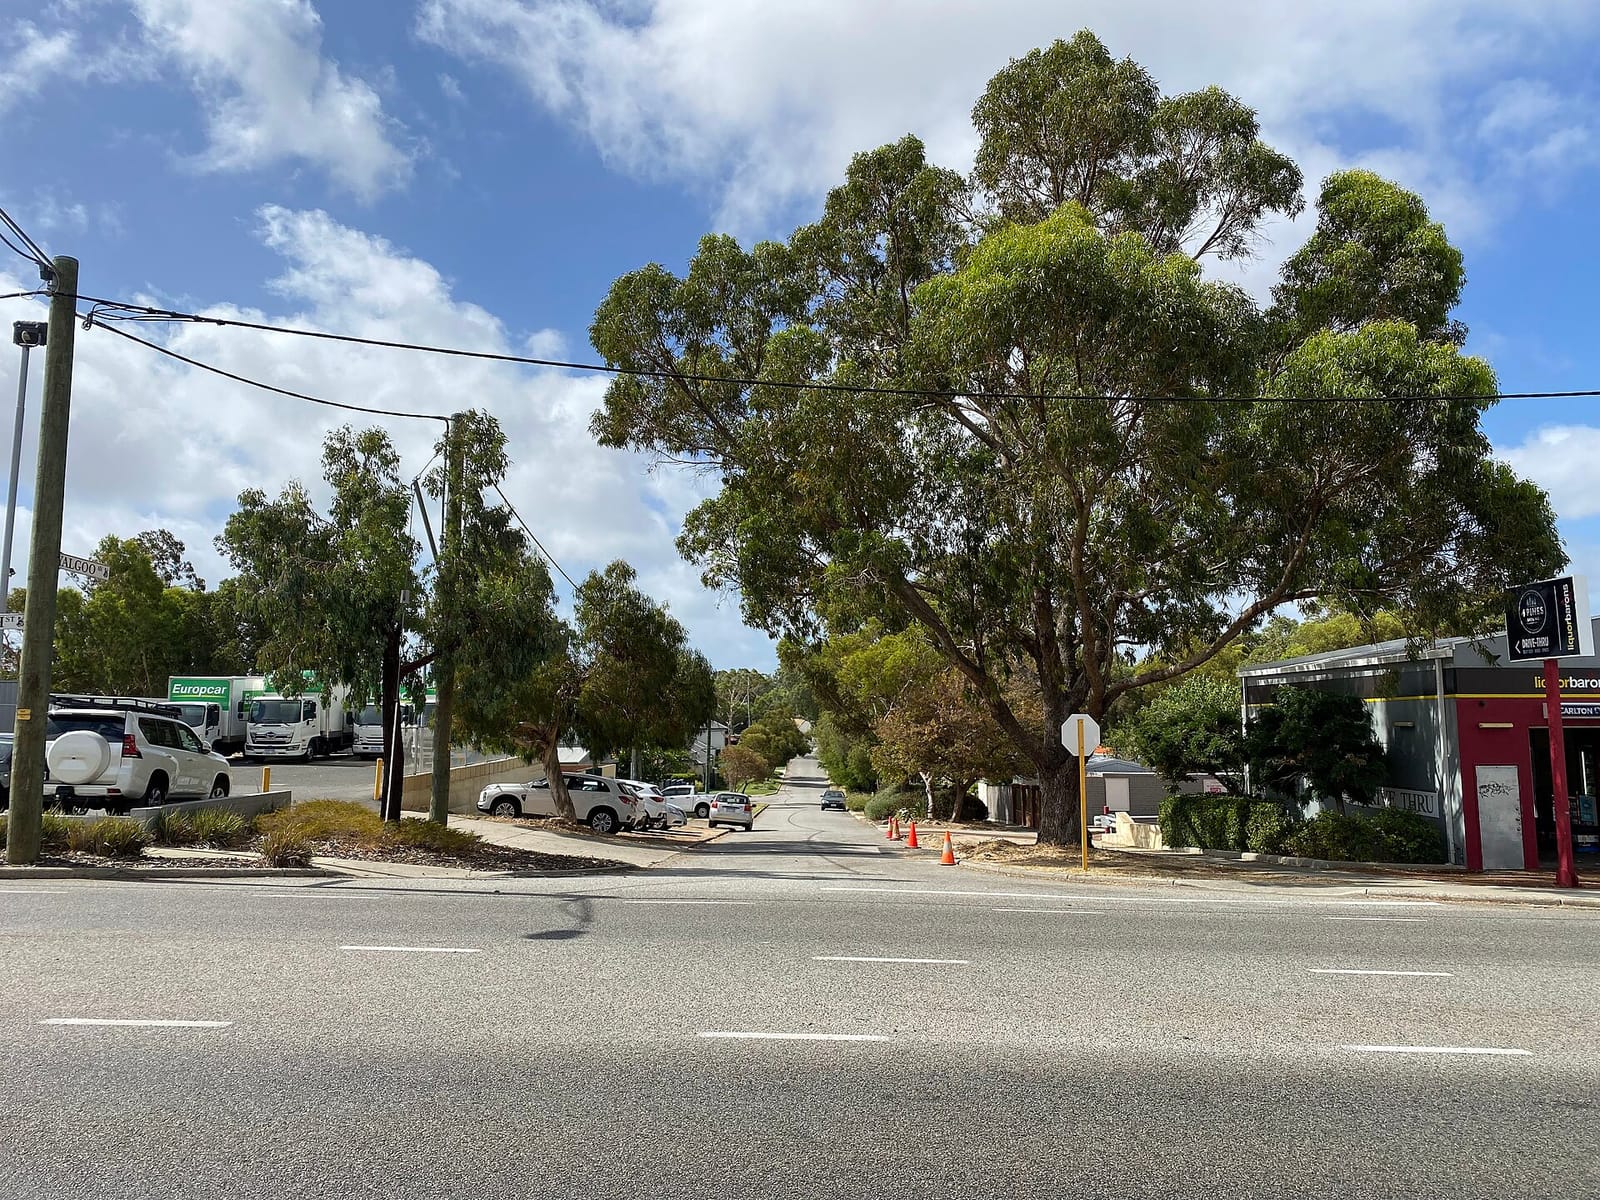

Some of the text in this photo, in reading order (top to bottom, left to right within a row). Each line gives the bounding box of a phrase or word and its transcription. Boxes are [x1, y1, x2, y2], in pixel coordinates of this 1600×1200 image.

[1563, 584, 1575, 651] liquorbarons
[1521, 636, 1549, 649] DRIVE-THRU
[172, 683, 227, 697] Europcar
[1400, 792, 1434, 814] THRU
